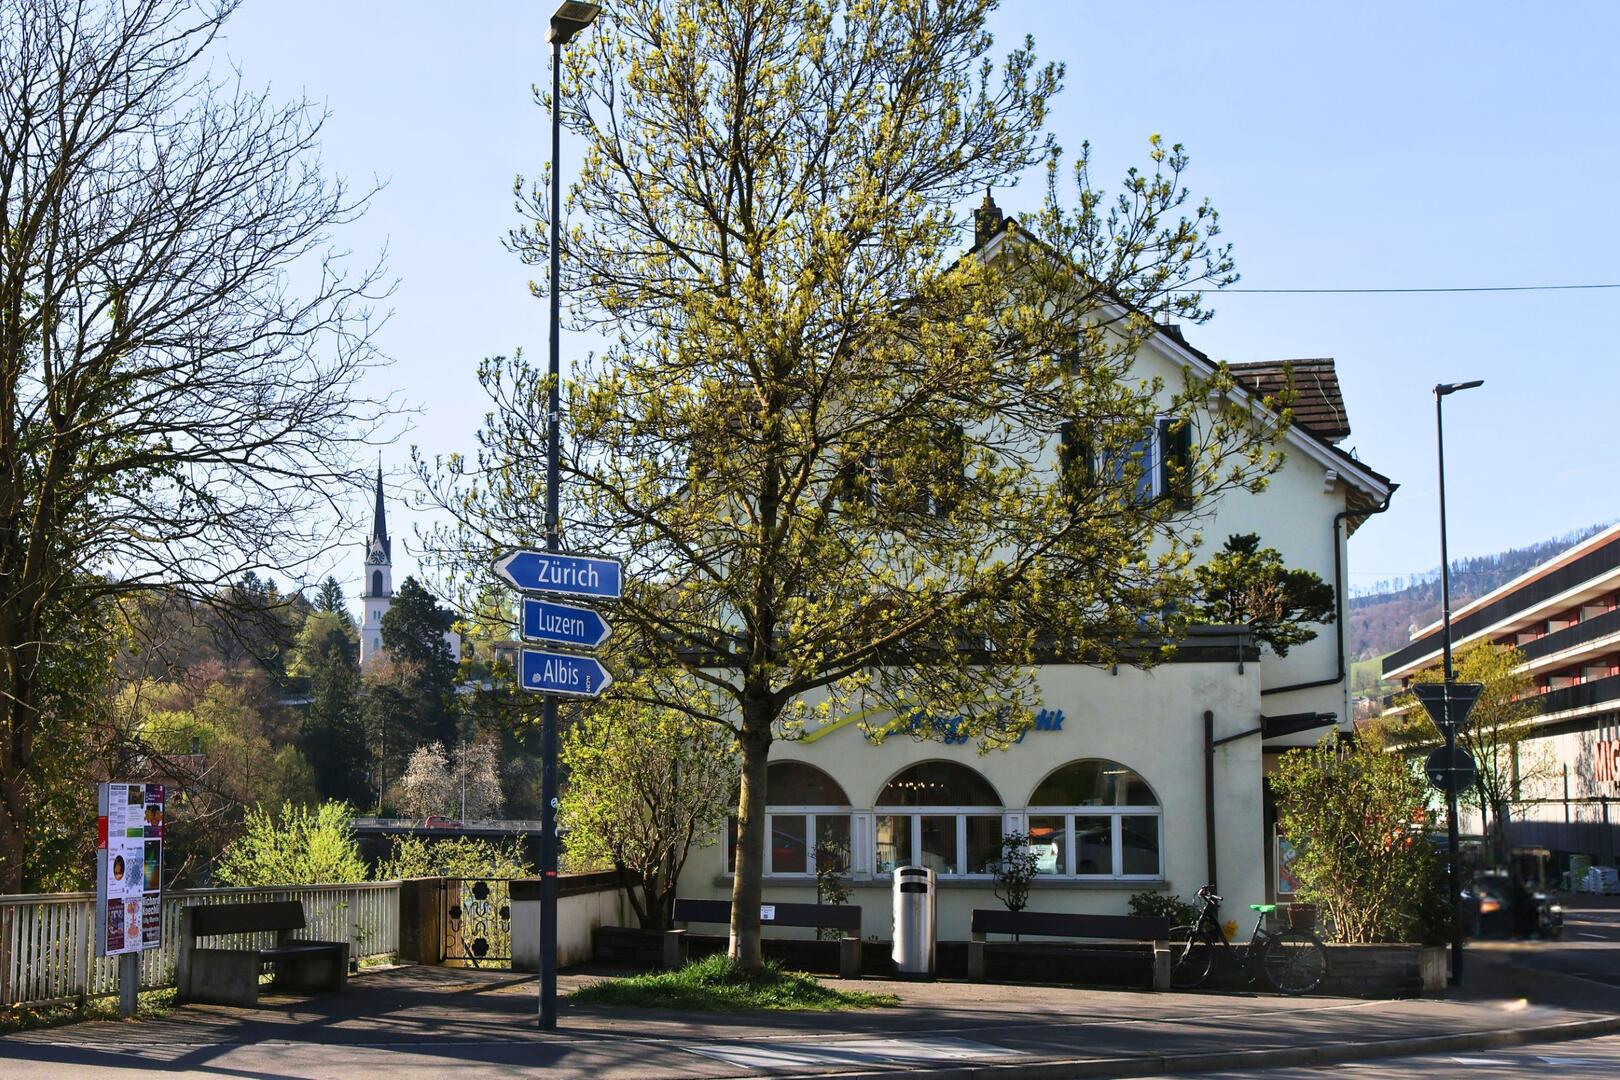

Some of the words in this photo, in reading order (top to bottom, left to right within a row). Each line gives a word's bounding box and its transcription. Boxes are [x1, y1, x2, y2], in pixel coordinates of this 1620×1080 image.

[538, 559, 598, 588] Zürich
[539, 607, 585, 637] Luzern
[543, 659, 579, 685] Albis
